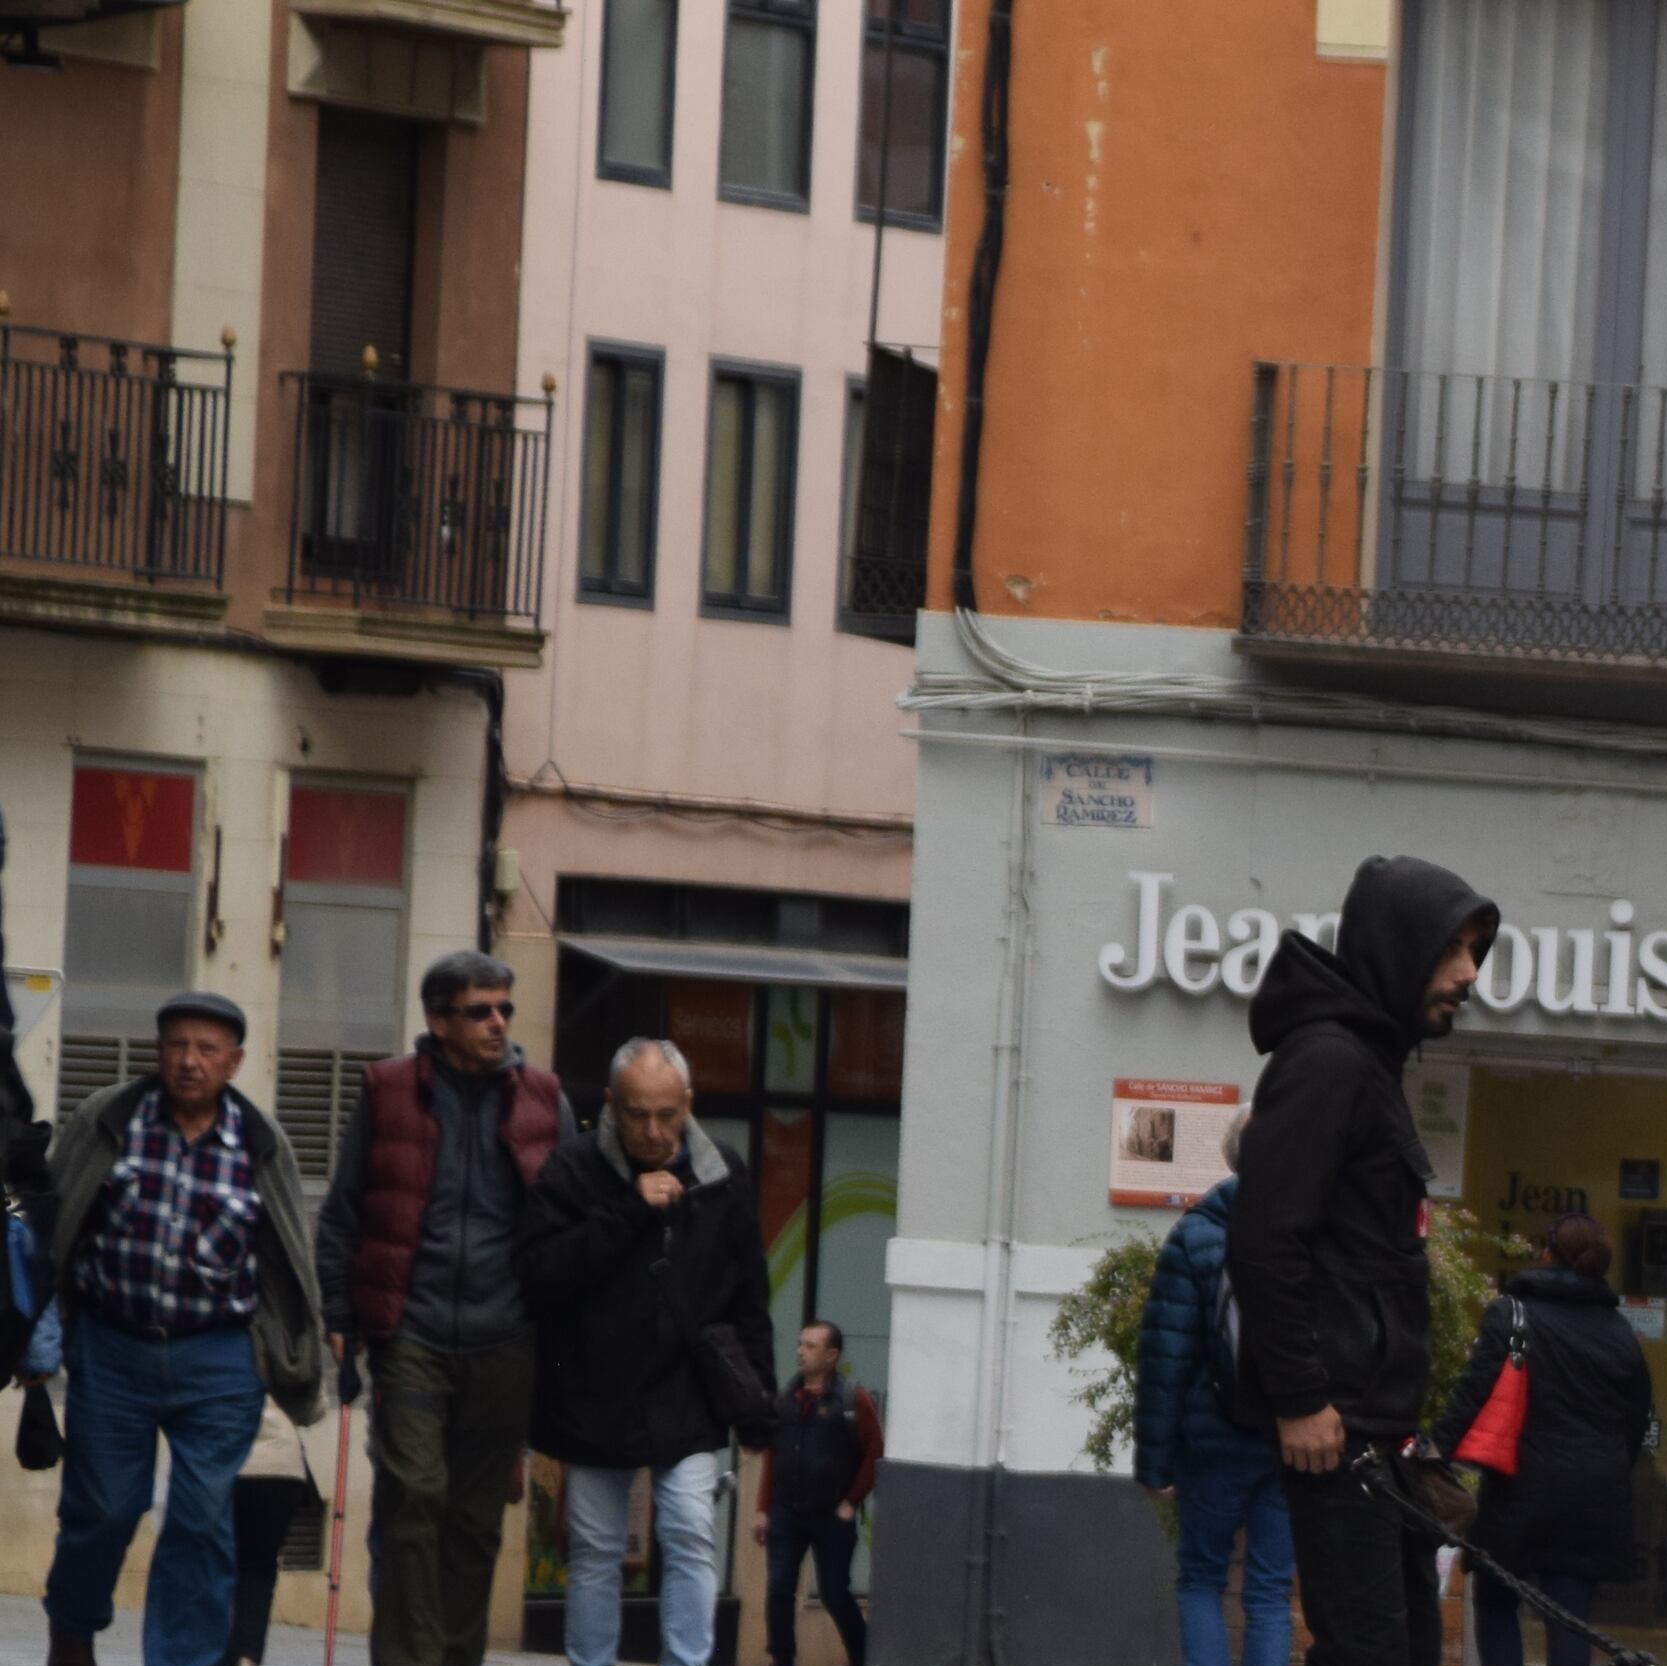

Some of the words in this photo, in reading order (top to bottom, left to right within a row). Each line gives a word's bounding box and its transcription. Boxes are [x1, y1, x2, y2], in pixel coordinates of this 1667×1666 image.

[1062, 790, 1135, 807] SANCHO
[1101, 871, 1342, 995] Jea
[1502, 1170, 1588, 1214] Jean
